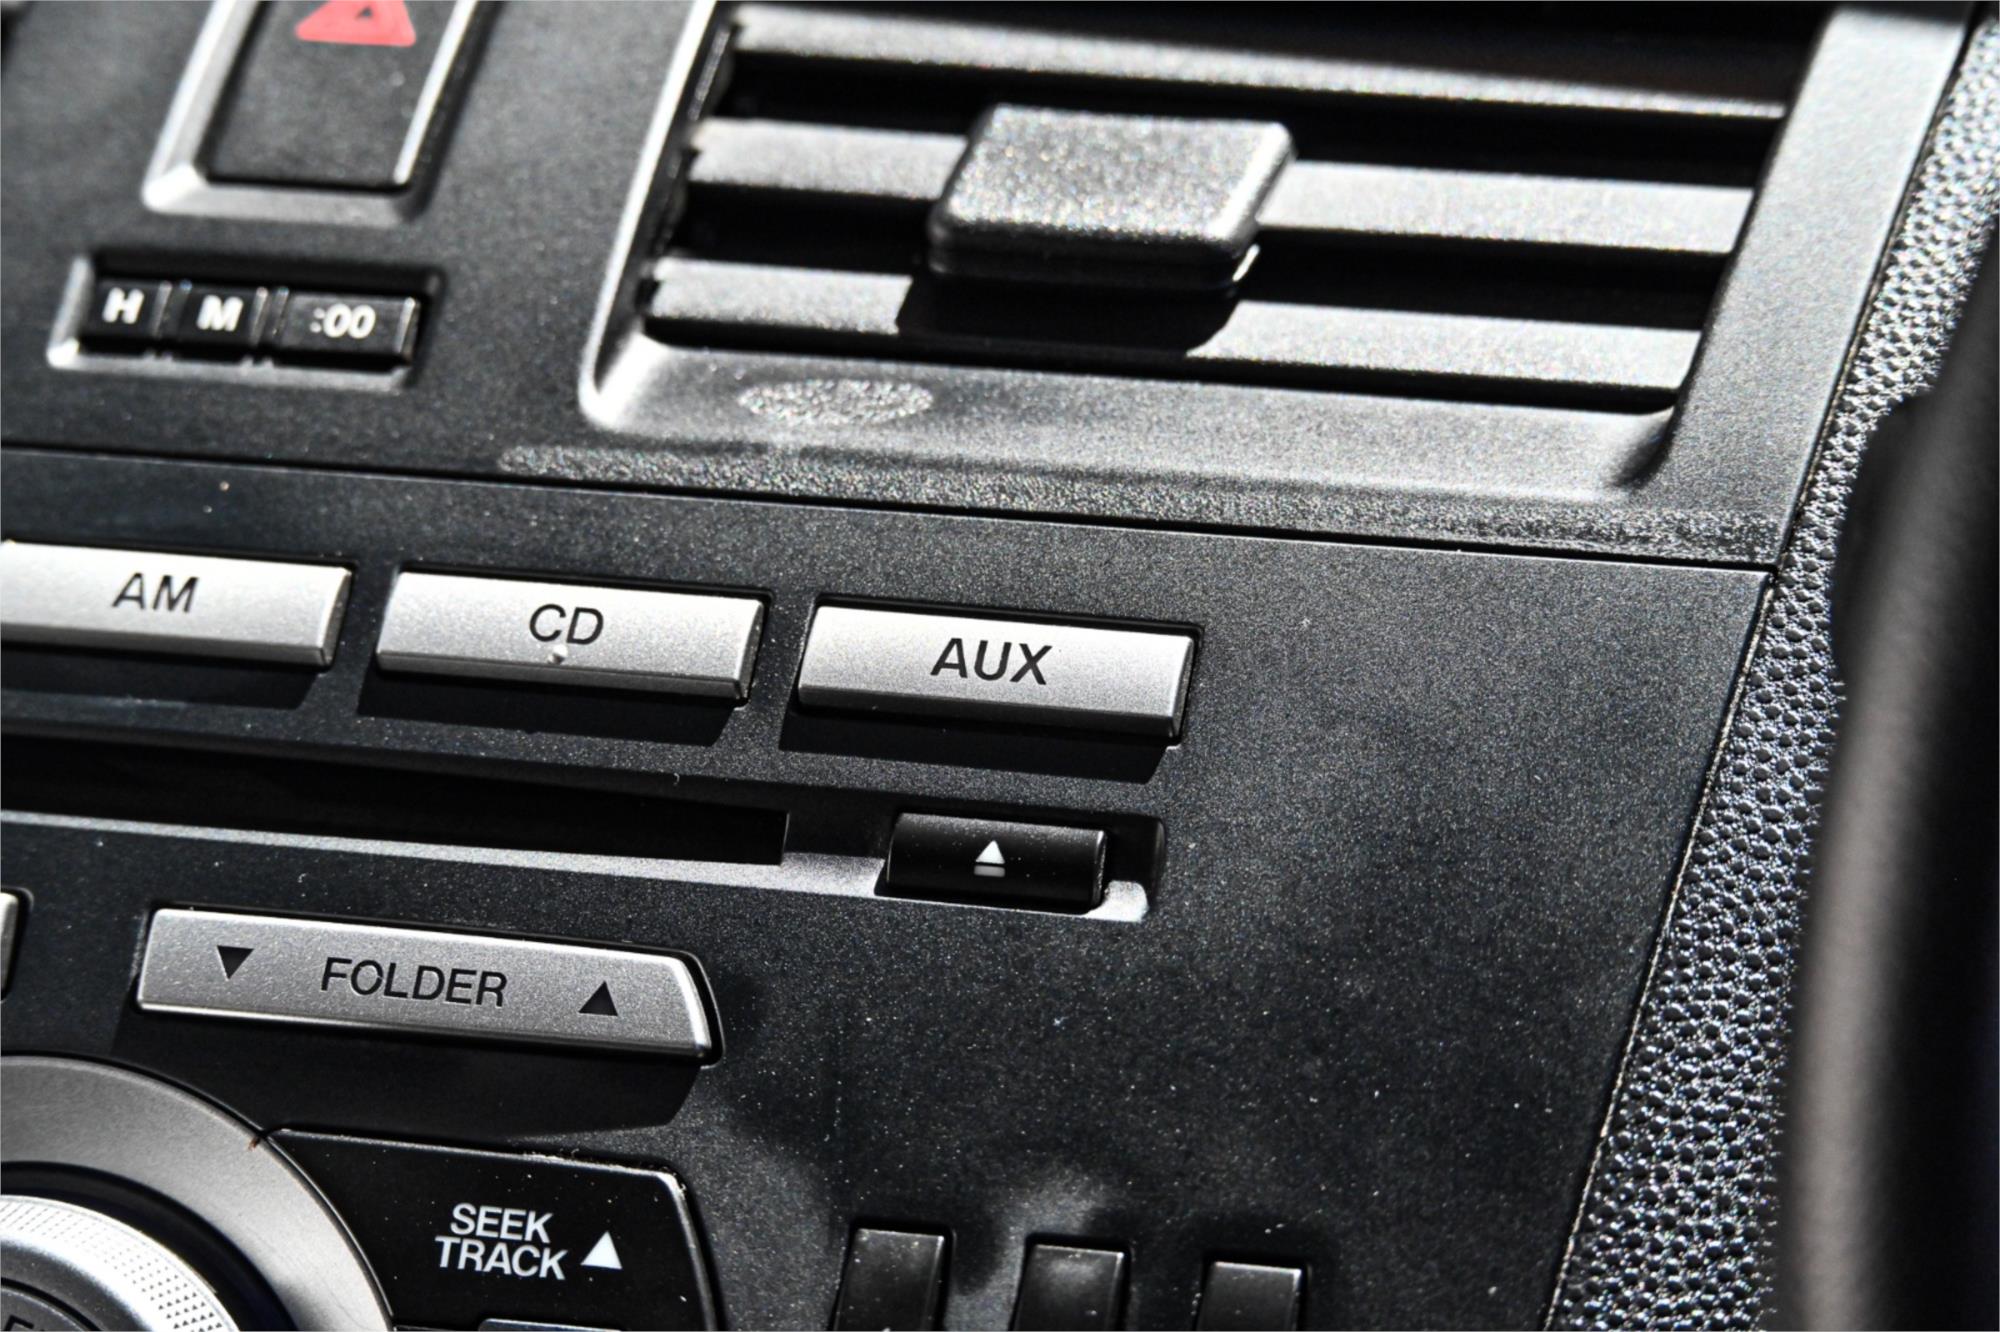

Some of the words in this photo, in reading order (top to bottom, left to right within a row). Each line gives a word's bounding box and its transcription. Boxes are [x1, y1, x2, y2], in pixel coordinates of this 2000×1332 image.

[111, 572, 199, 613] AM
[529, 604, 604, 645] CD
[930, 637, 1052, 685] AUX
[320, 956, 508, 1007] FOLDER
[450, 1202, 553, 1243] SEEK
[434, 1235, 568, 1280] TRACK
